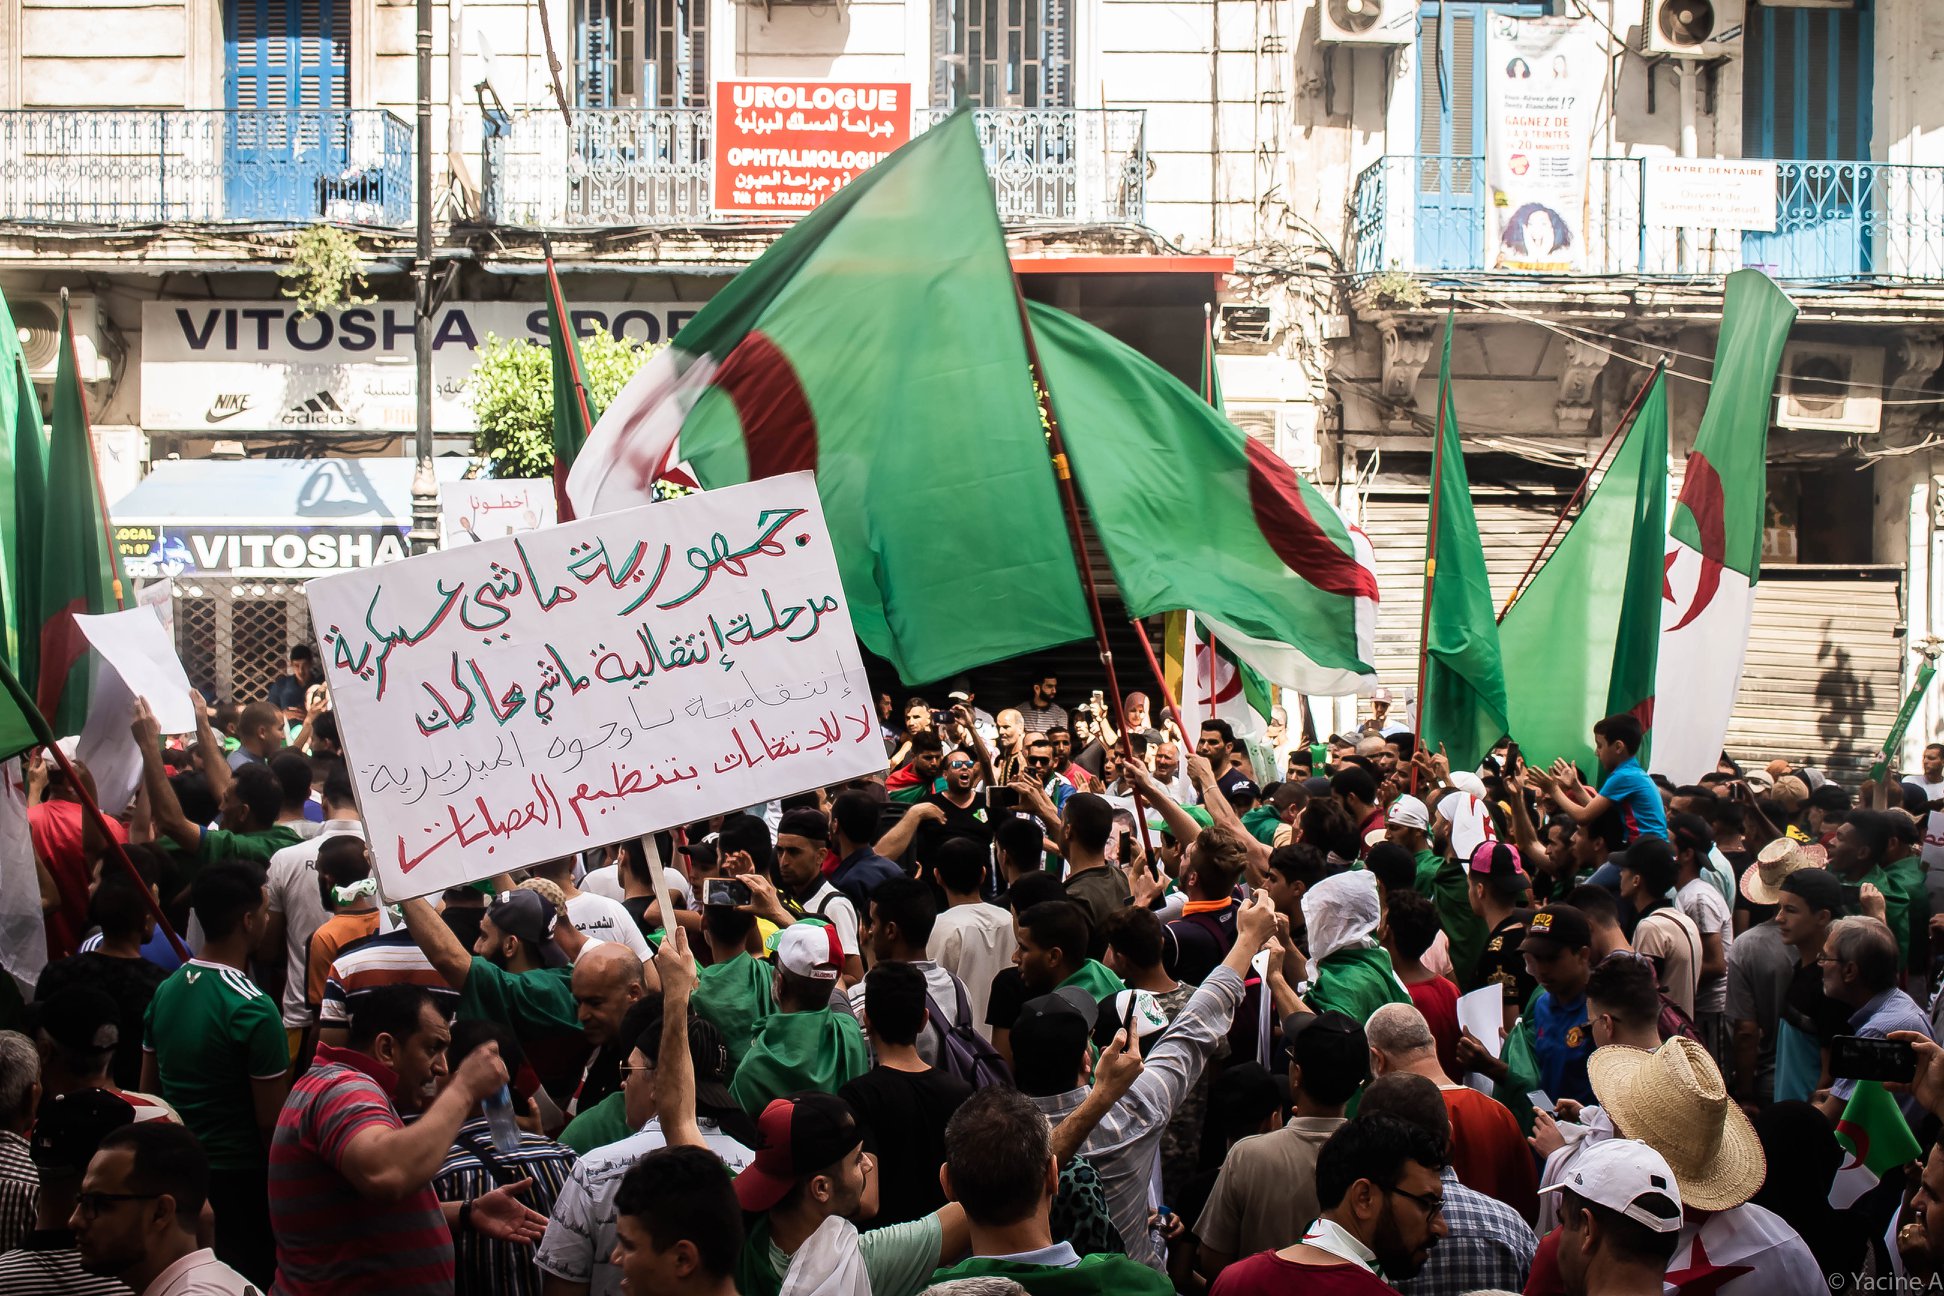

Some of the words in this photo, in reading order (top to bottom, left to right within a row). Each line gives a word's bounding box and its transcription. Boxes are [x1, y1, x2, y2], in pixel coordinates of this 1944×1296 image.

[733, 86, 897, 111] UROLOGUE
[734, 107, 784, 135] البولية
[841, 110, 895, 138] جراحة
[1505, 115, 1550, 127] GAGNEZ
[1554, 117, 1569, 127] DE
[1532, 130, 1570, 139] TEINTES
[1518, 140, 1533, 150] 20
[734, 170, 781, 189] العيون
[783, 169, 830, 191] جراحة
[1659, 165, 1703, 174] CENTRE
[1708, 167, 1766, 176] DENTAIRE
[175, 308, 479, 351] VITOSHA
[214, 393, 251, 410] NIKE
[282, 412, 357, 425] adidas
[191, 534, 409, 568] VITOSHA
[568, 509, 812, 616] جمهورية
[460, 535, 578, 646] ماشي
[725, 588, 839, 647] مرحلة
[323, 579, 465, 702] عسكرية
[535, 642, 591, 726] ماشي
[844, 703, 872, 744] لا
[397, 772, 562, 875] العصابات
[589, 915, 614, 933] الشعب
